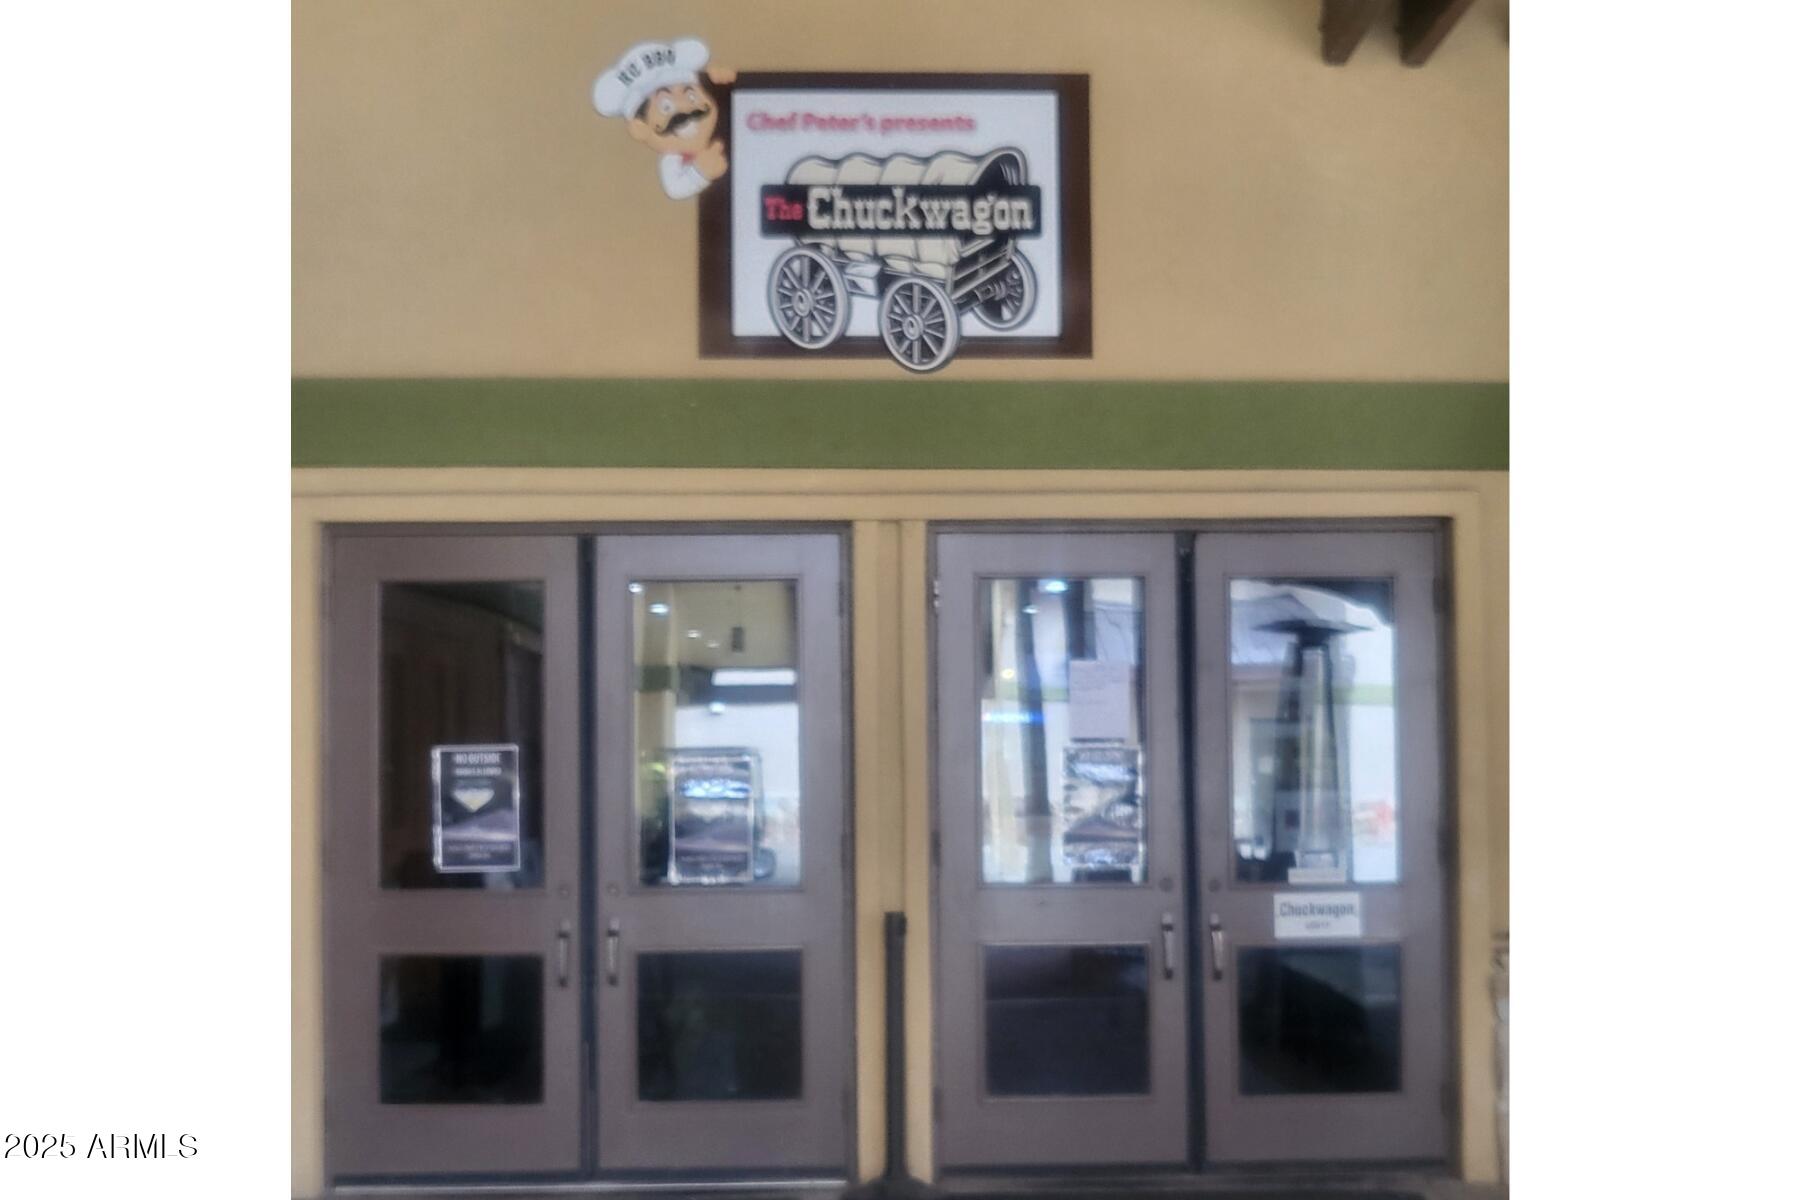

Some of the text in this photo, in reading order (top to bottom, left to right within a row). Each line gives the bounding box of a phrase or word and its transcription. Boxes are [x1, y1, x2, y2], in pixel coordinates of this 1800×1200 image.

[747, 112, 975, 135] Chef Peter's presents
[765, 186, 1034, 235] The Chuckwagon
